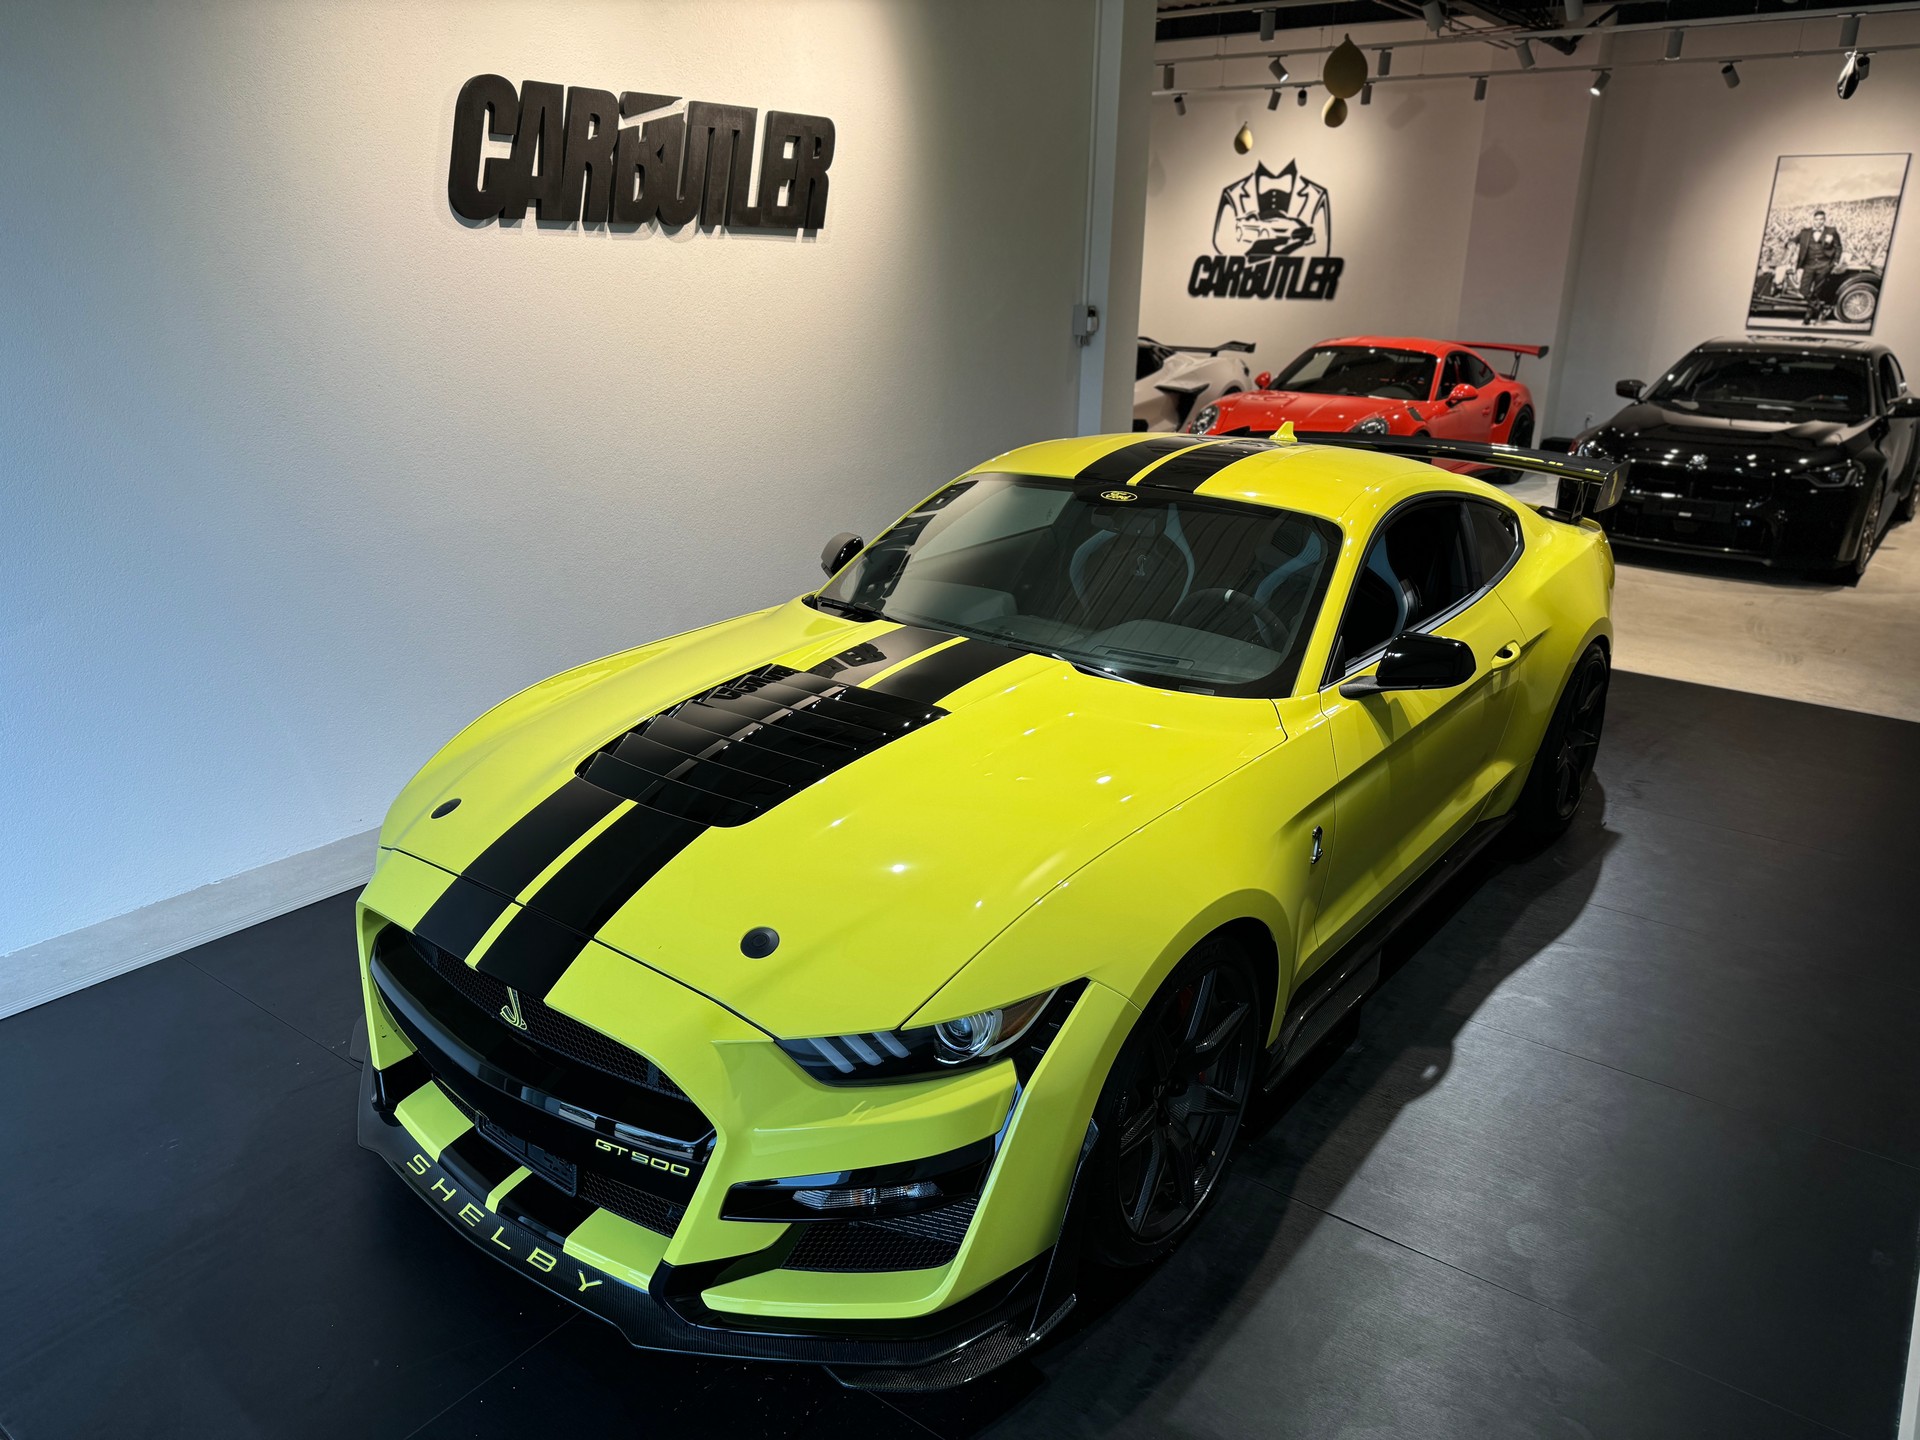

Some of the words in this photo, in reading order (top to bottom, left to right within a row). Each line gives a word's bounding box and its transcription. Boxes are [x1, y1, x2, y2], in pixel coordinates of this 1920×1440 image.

[448, 74, 835, 229] CARBUTLER
[1188, 255, 1344, 300] CARBUTLER
[406, 1154, 603, 1292] SHELBY
